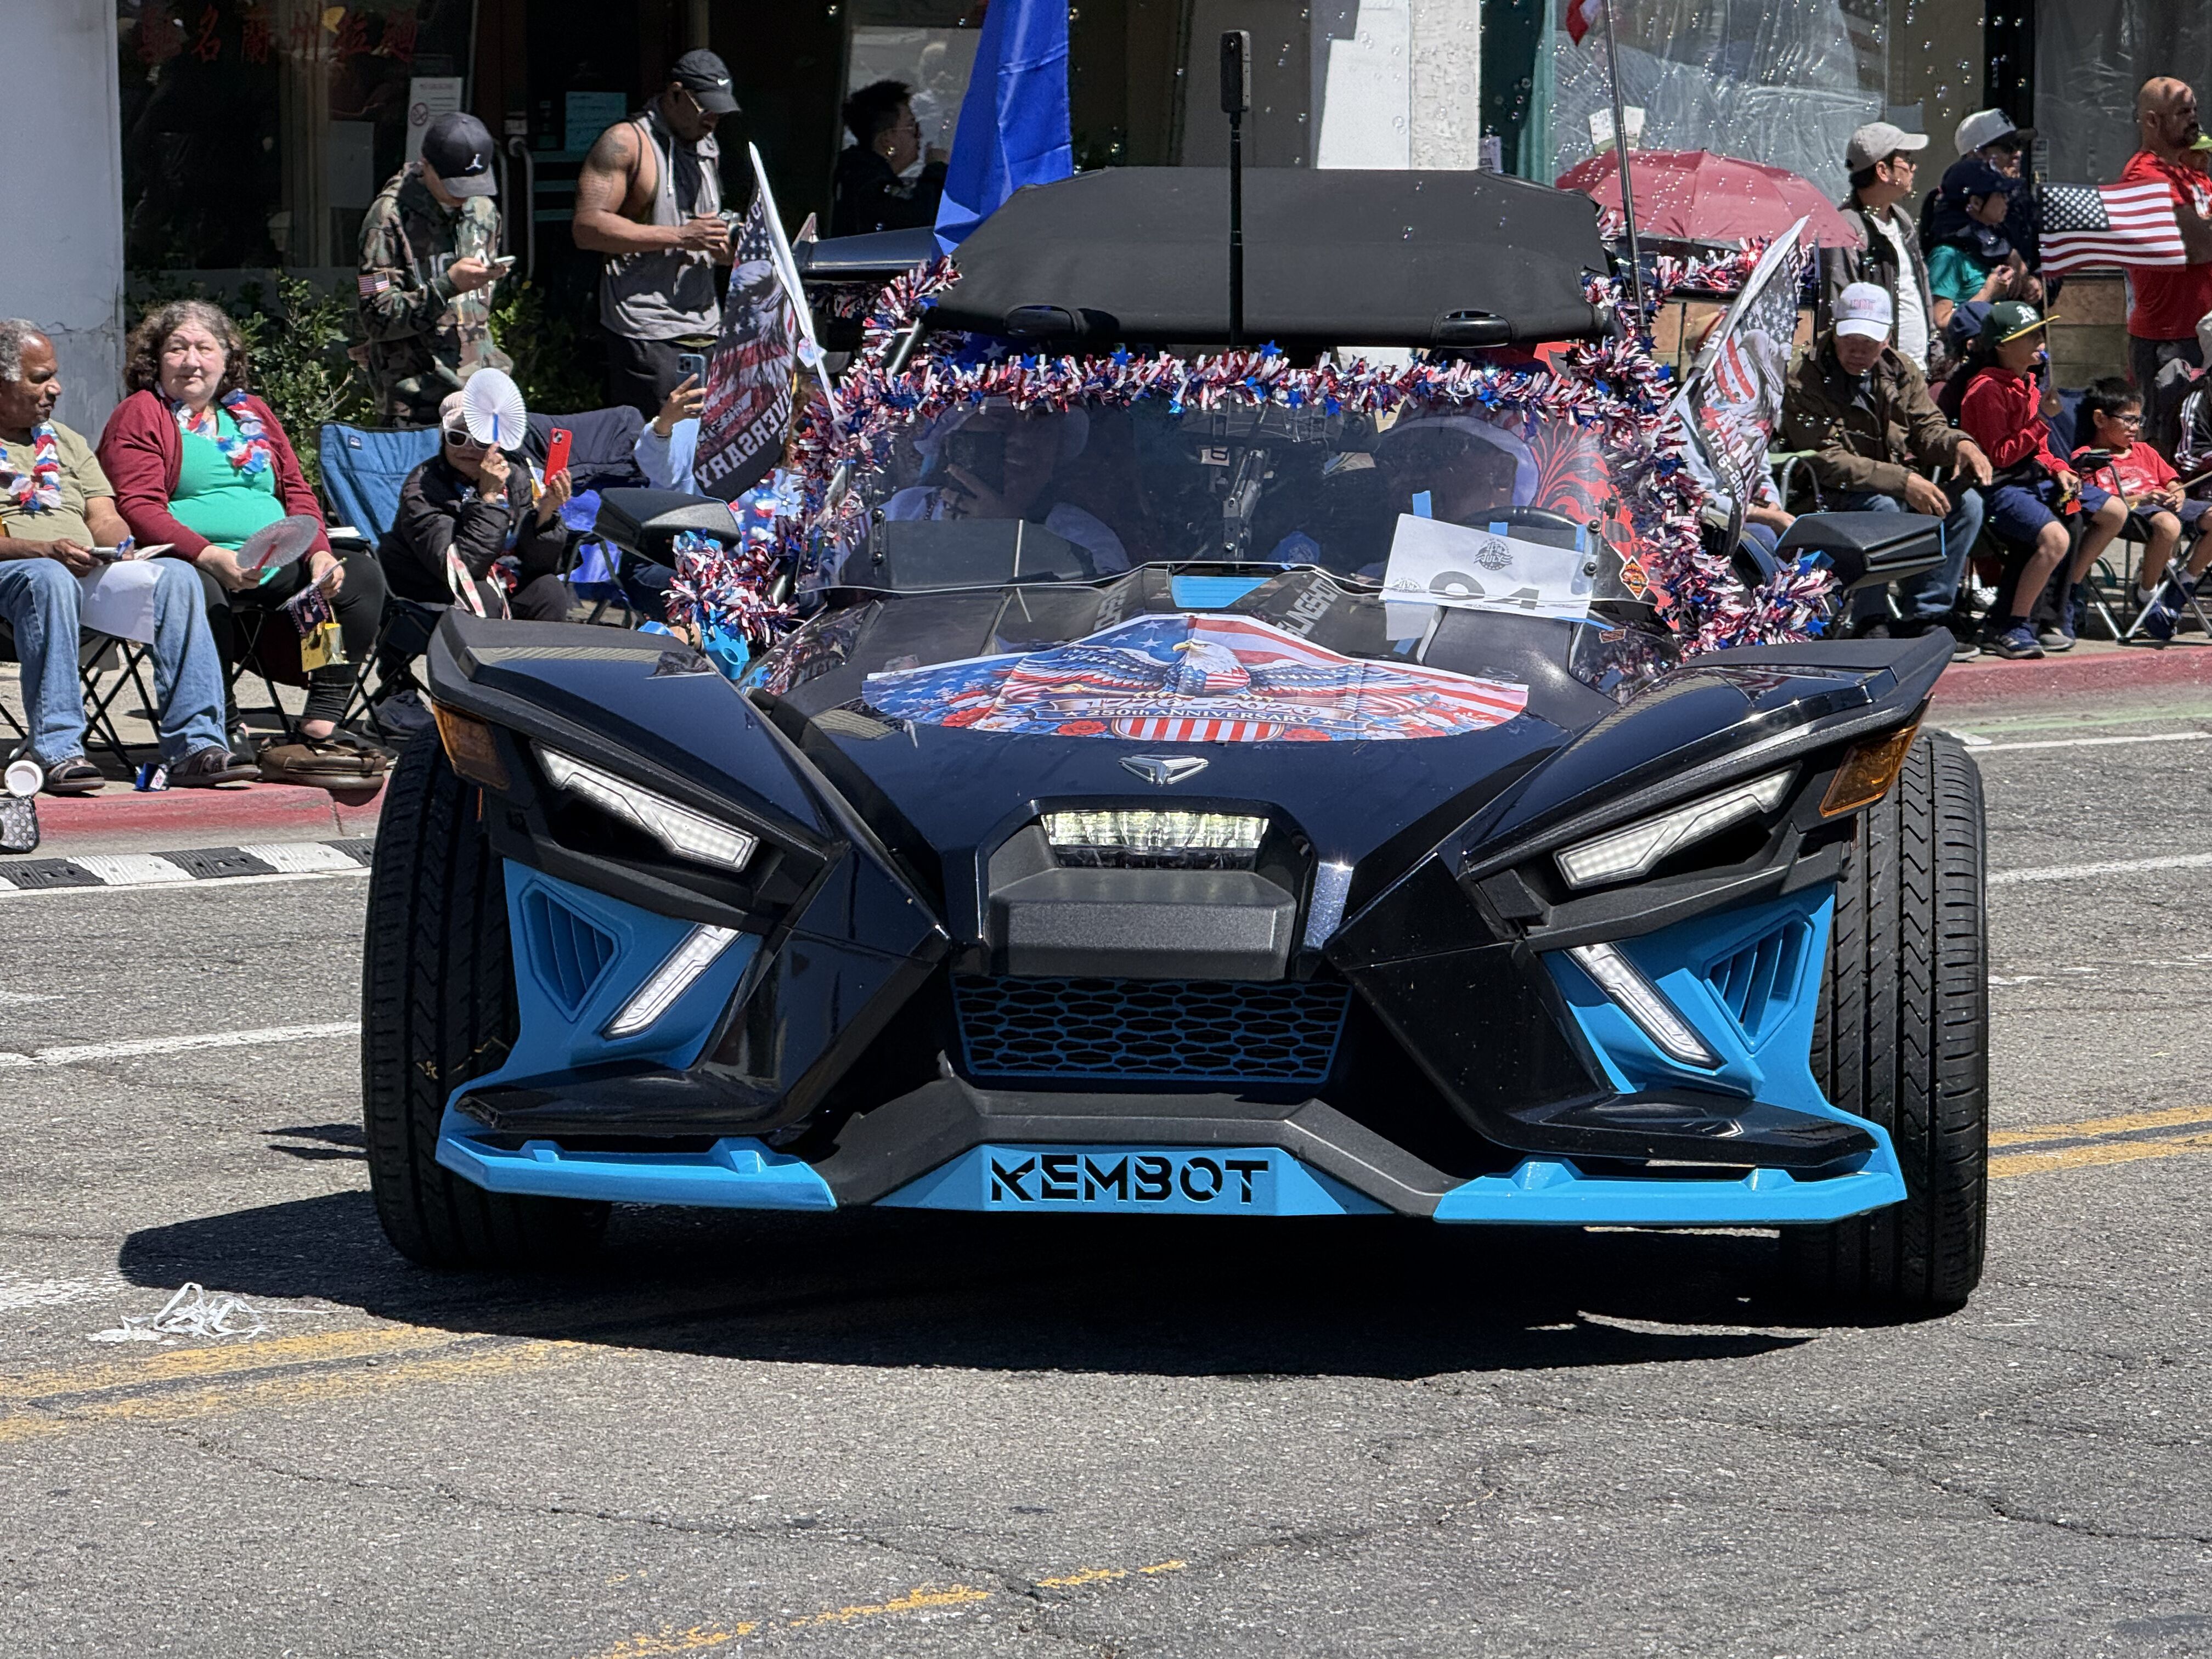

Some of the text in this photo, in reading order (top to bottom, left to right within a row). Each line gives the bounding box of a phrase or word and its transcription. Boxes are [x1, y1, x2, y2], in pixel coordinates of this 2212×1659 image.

[1707, 429, 1745, 504] 1776-202
[1480, 553, 1504, 563] JULY
[1154, 708, 1313, 724] ANNIVERSARY
[990, 1153, 1269, 1206] KEMBOT
